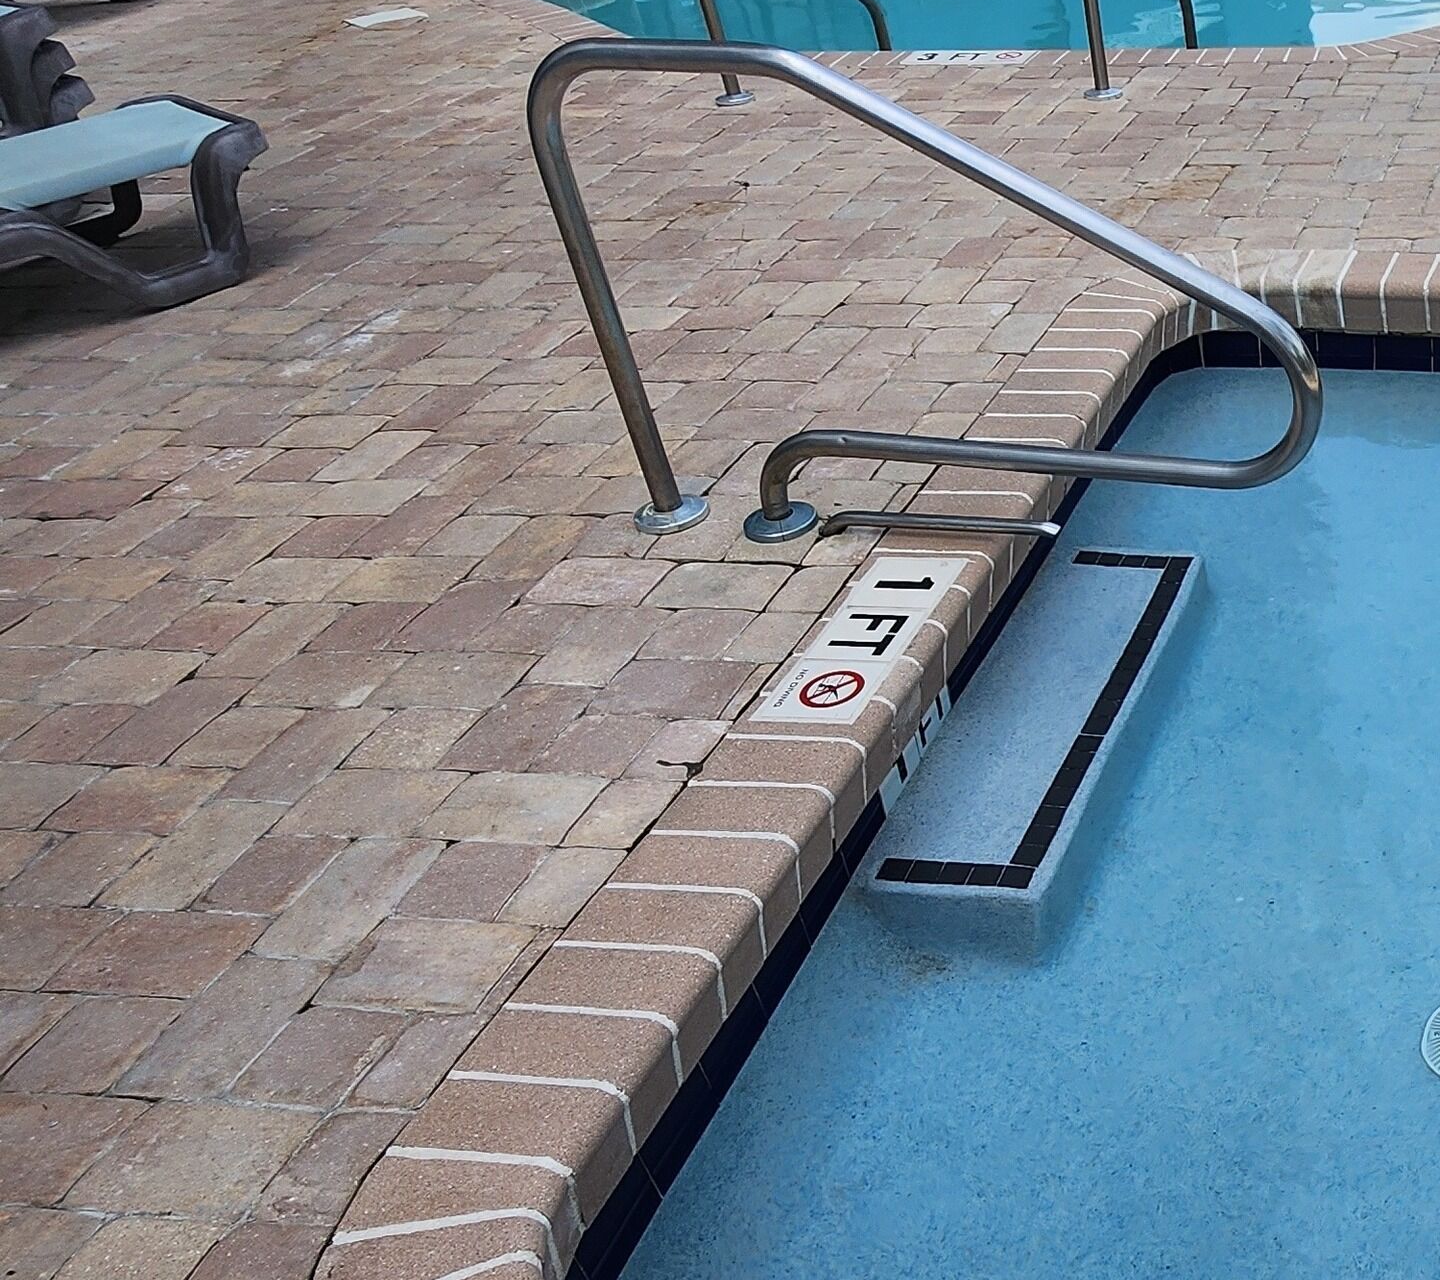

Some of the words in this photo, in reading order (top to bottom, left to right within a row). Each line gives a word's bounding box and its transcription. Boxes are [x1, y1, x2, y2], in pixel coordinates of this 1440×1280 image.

[916, 53, 938, 61] 3
[948, 52, 988, 61] FT
[873, 576, 935, 590] 1
[827, 613, 910, 656] FT
[795, 668, 809, 680] NO
[773, 681, 798, 707] DIVING
